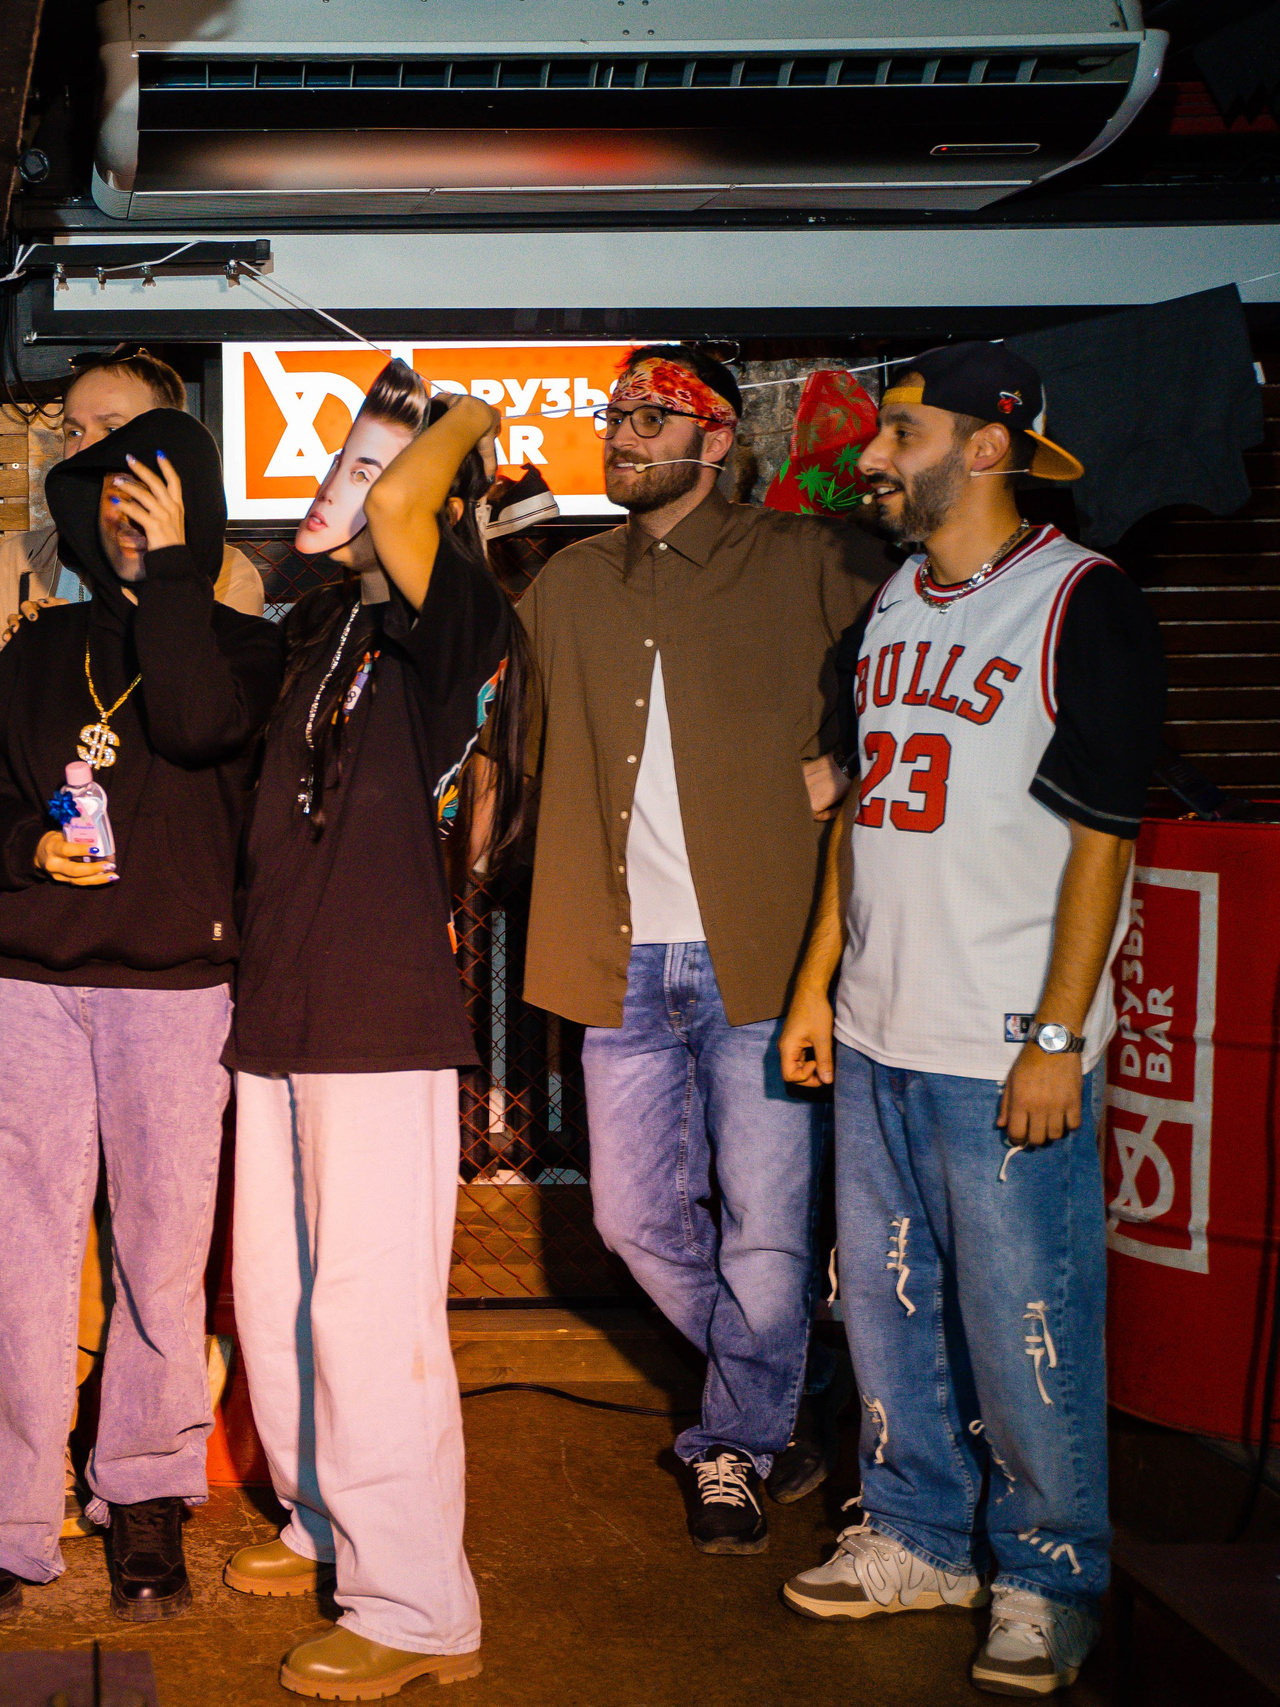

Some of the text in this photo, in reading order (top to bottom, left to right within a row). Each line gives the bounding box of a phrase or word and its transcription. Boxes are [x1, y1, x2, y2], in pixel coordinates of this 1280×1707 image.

[430, 377, 622, 419] РУЗЬ
[855, 640, 1023, 726] BULLS
[854, 730, 952, 834] 23
[1145, 985, 1175, 1084] BAR
